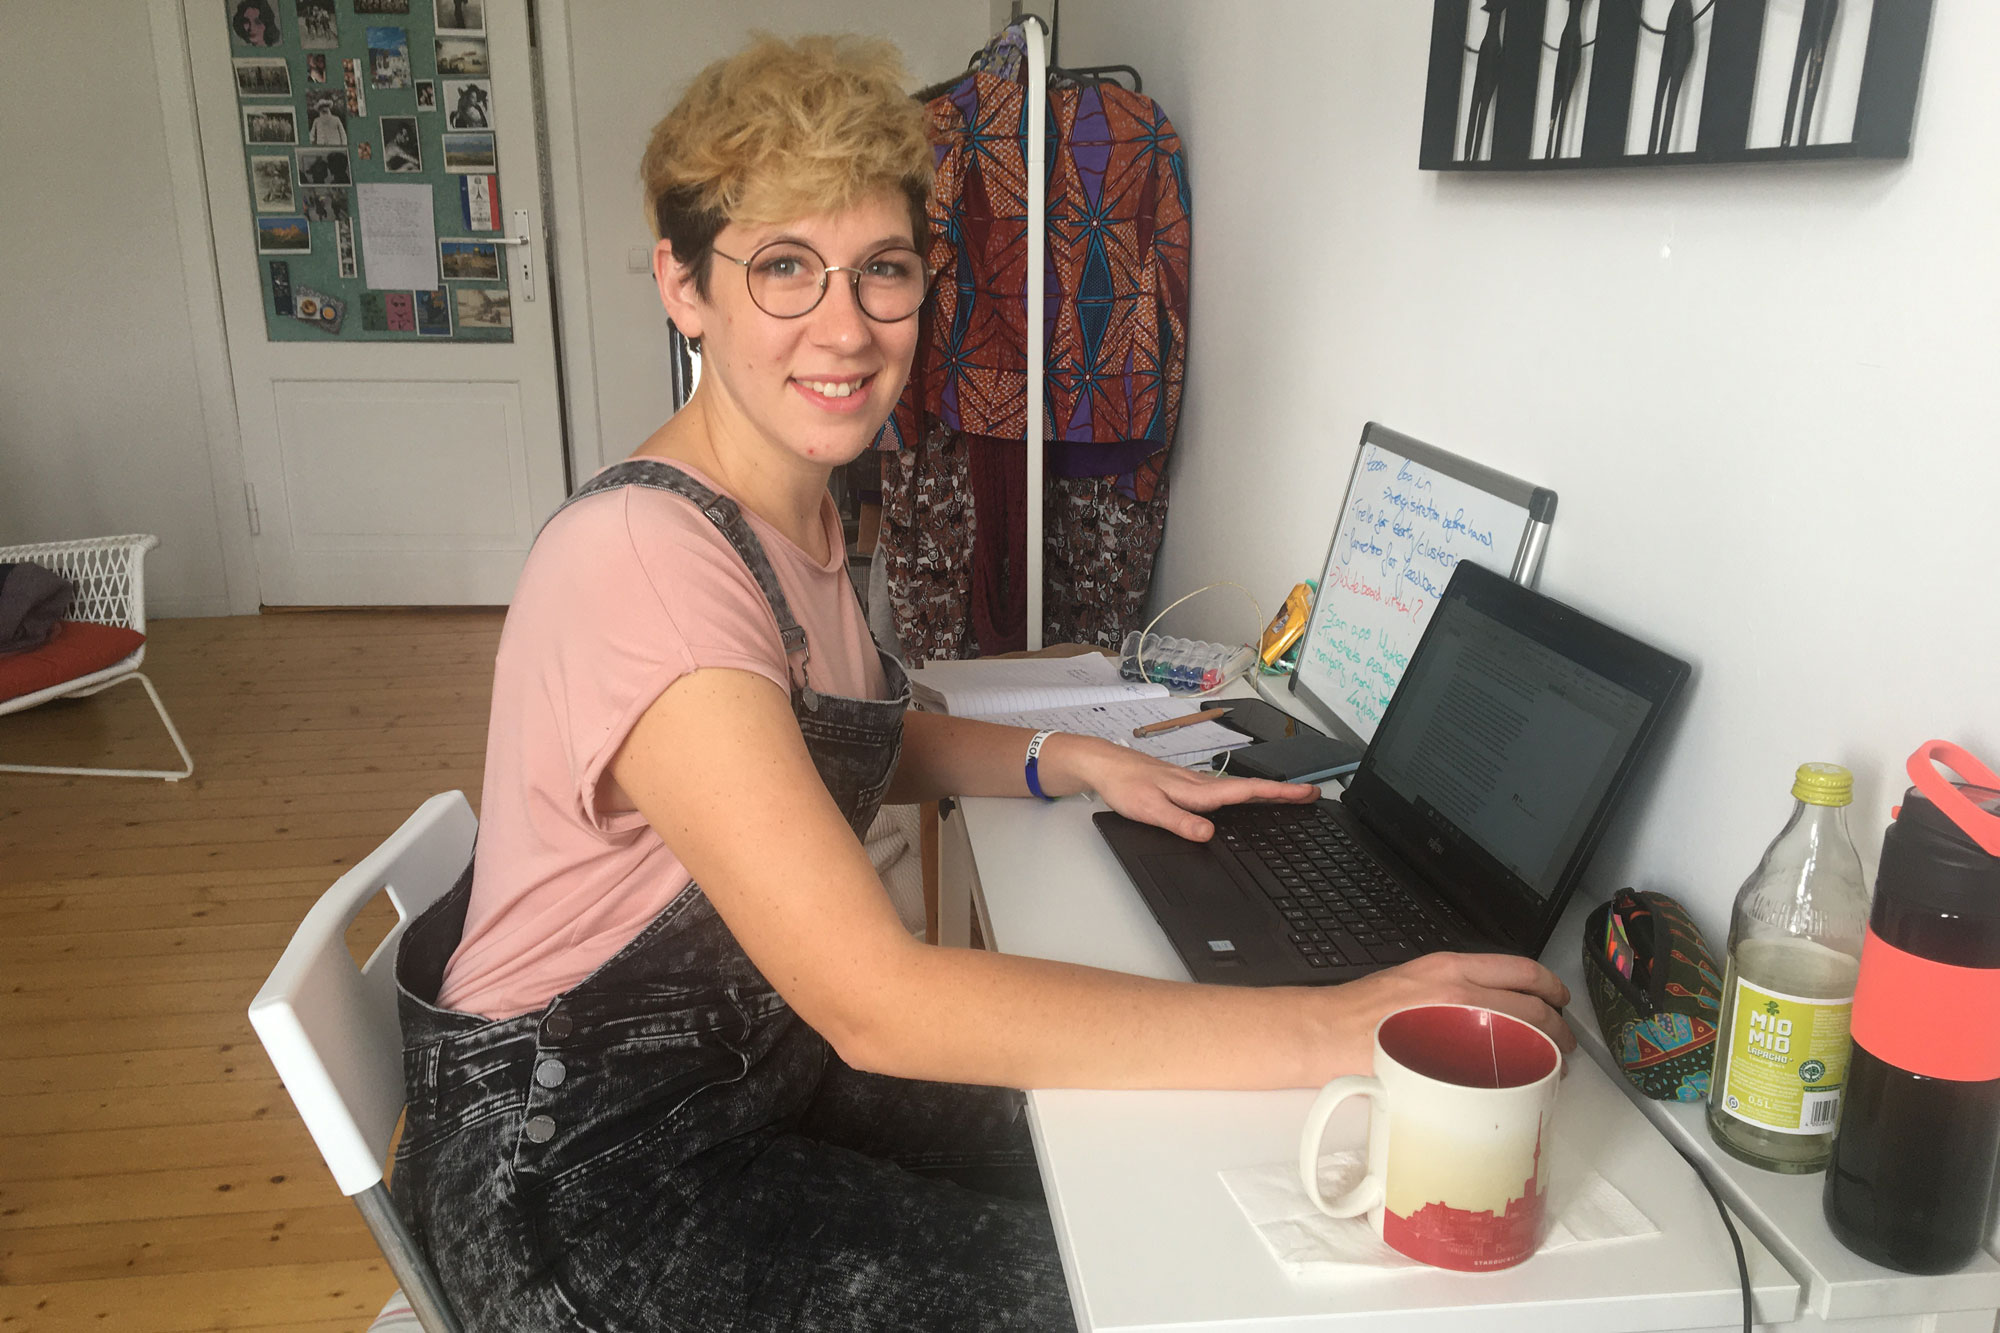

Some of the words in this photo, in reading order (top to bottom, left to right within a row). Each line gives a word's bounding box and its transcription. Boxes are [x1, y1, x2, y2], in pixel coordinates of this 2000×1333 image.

[1750, 1010, 1793, 1036] MIO
[1748, 1029, 1791, 1054] MIO
[1747, 1045, 1787, 1064] LAPACHO
